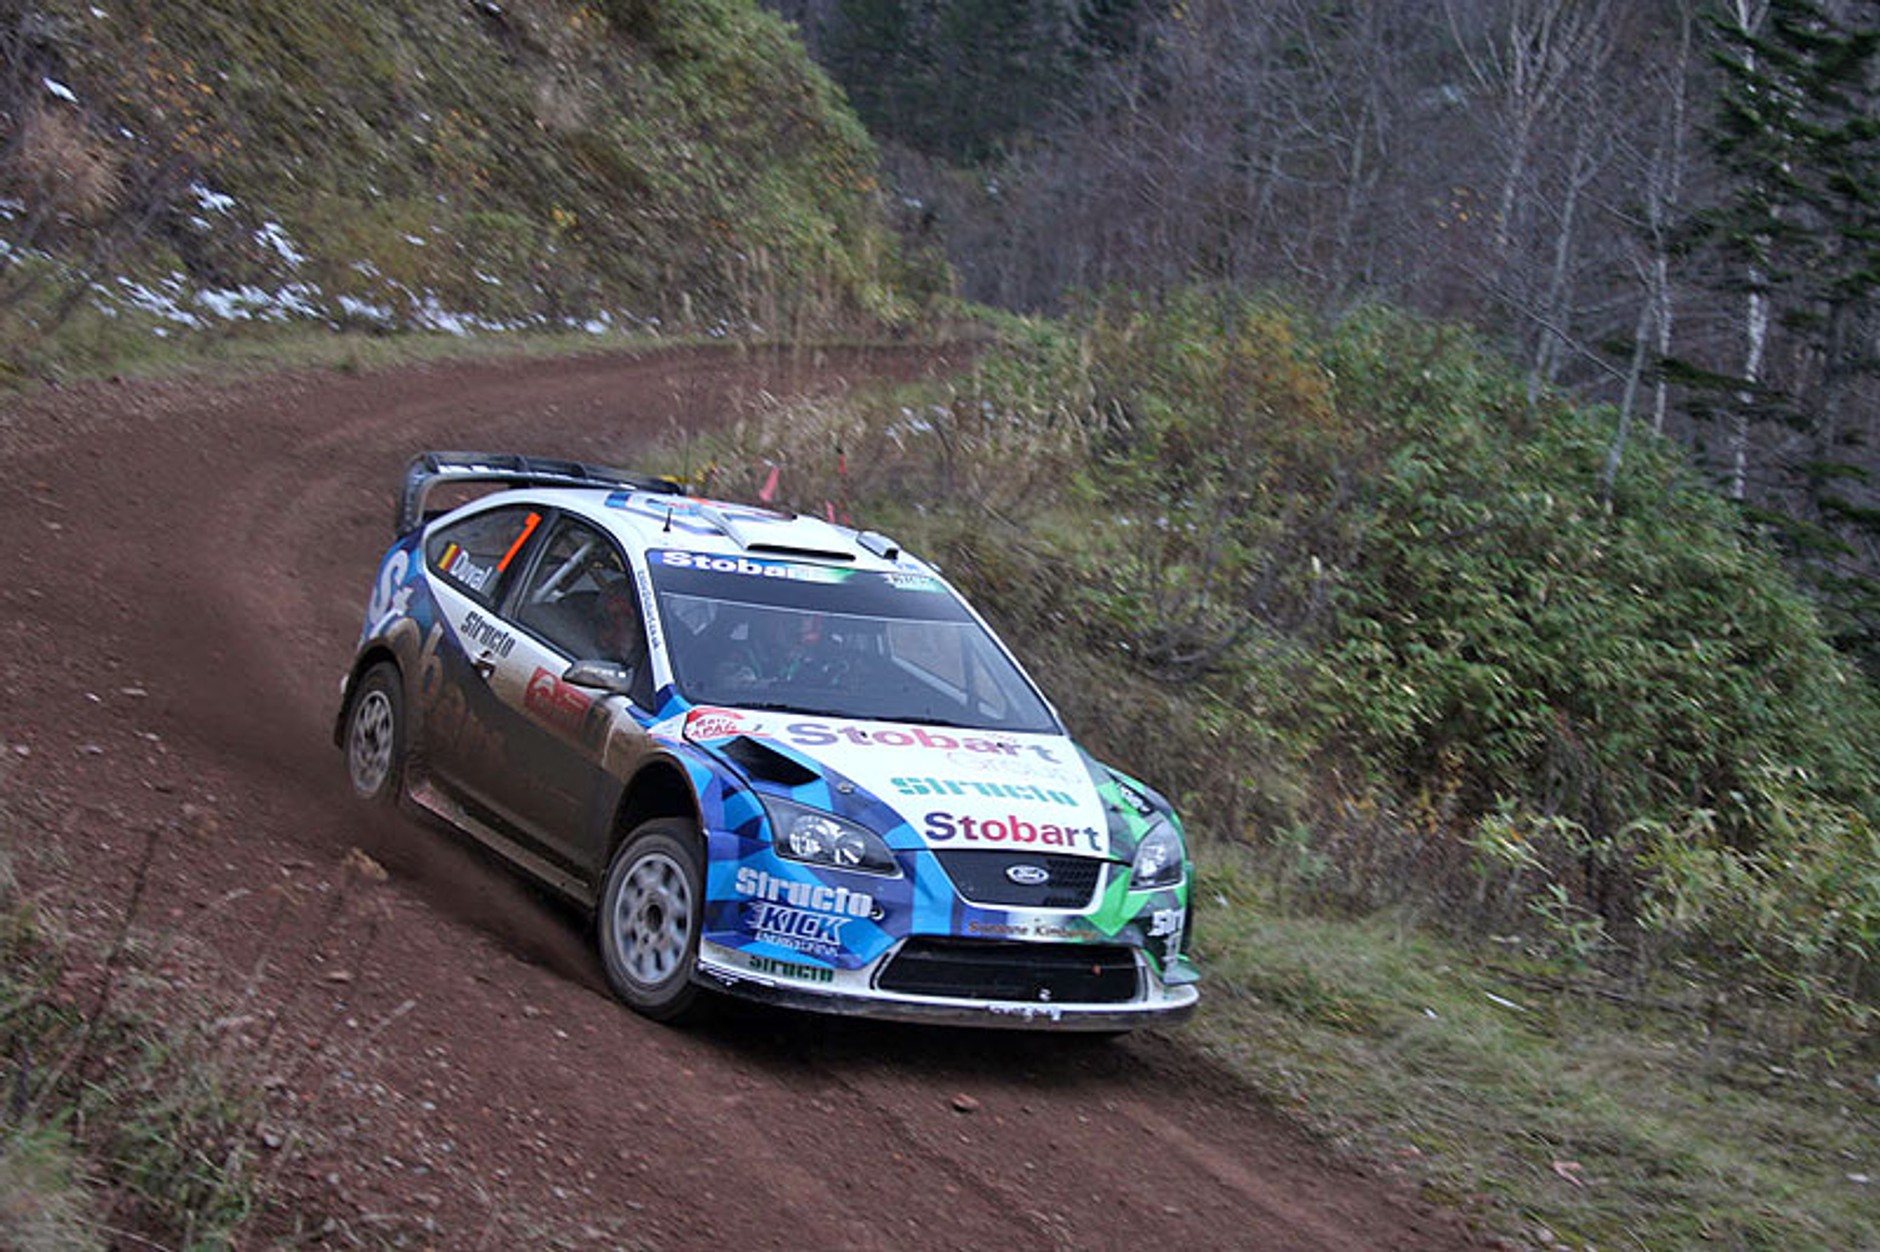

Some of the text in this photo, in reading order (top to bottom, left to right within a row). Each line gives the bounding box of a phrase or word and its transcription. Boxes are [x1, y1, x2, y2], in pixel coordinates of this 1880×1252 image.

[496, 512, 542, 573] 1
[449, 549, 493, 592] Duval
[787, 722, 1063, 765] Stobart
[890, 776, 1080, 808] structo
[924, 811, 1102, 852] Stobart
[735, 866, 873, 919] structo
[761, 904, 851, 945] KICK
